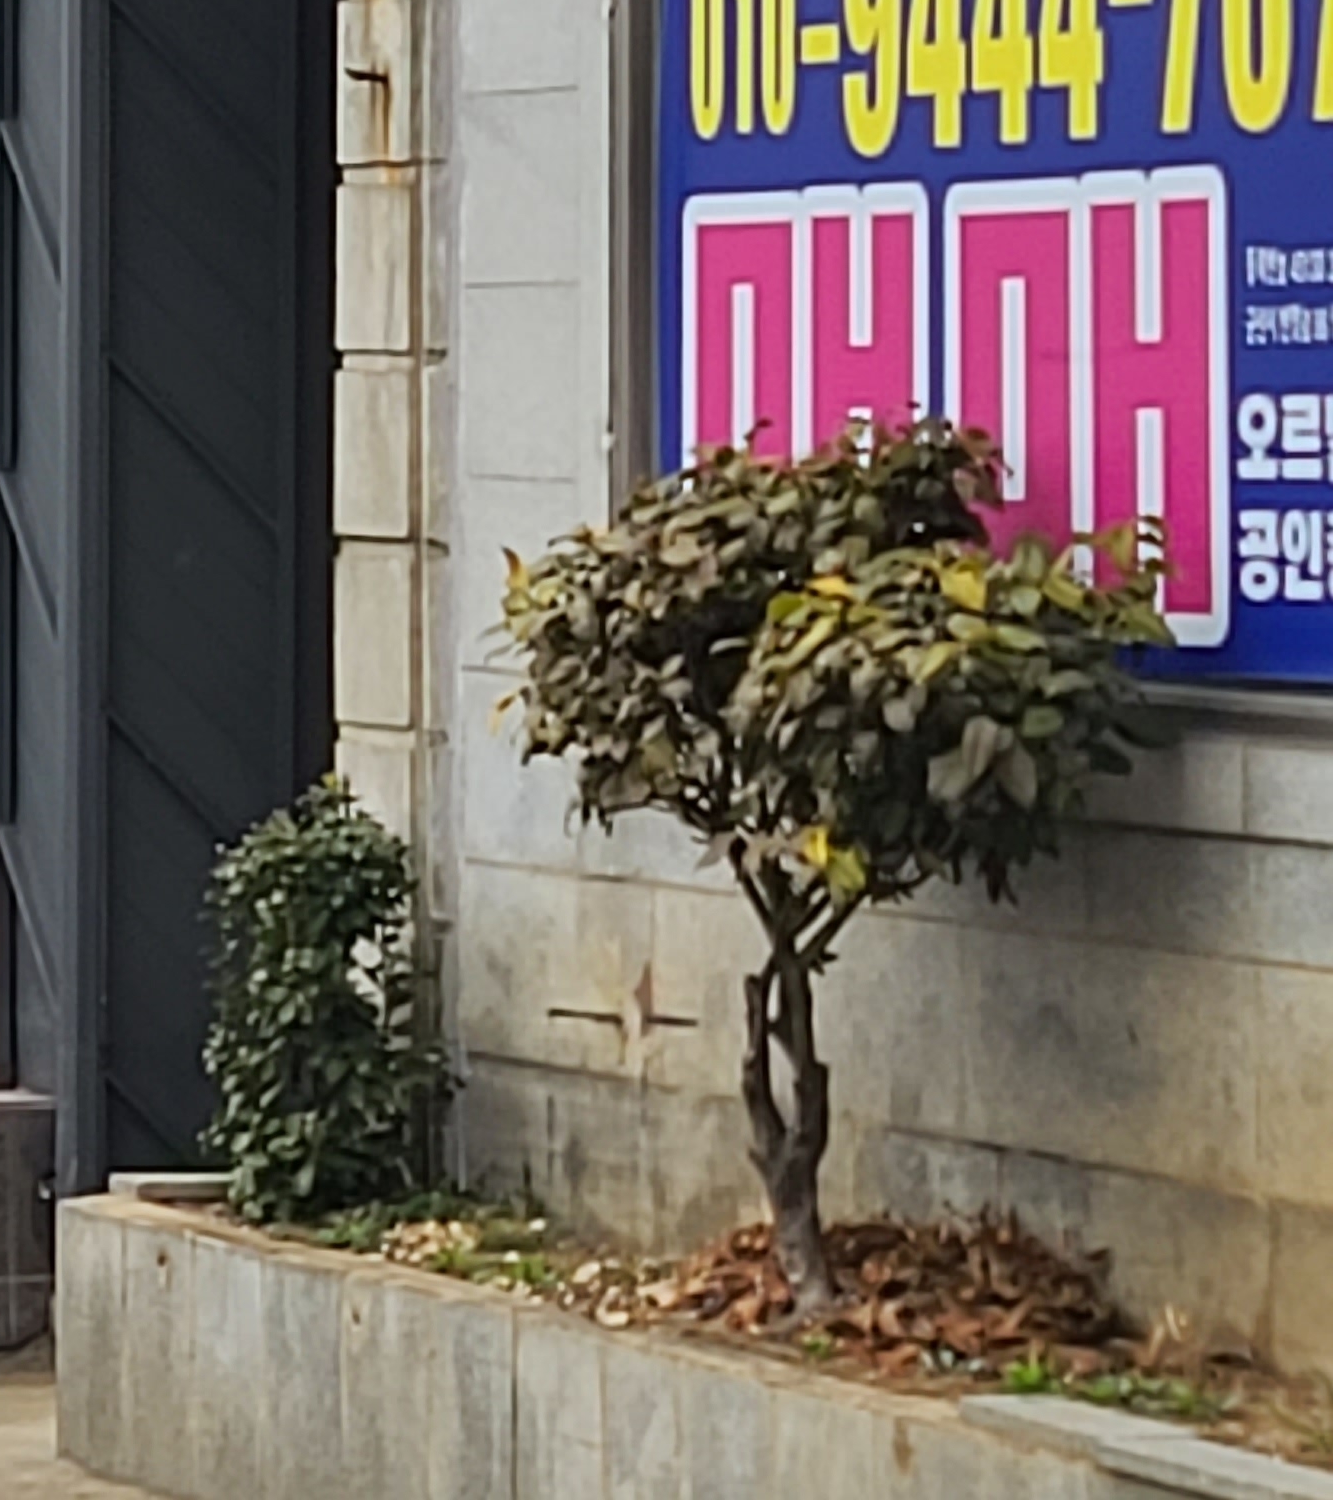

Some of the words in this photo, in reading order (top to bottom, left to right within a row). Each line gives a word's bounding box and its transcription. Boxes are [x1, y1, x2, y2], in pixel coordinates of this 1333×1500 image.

[683, 164, 1231, 648] 매매
[1237, 392, 1333, 481] 오르
[1239, 508, 1333, 602] 공인
